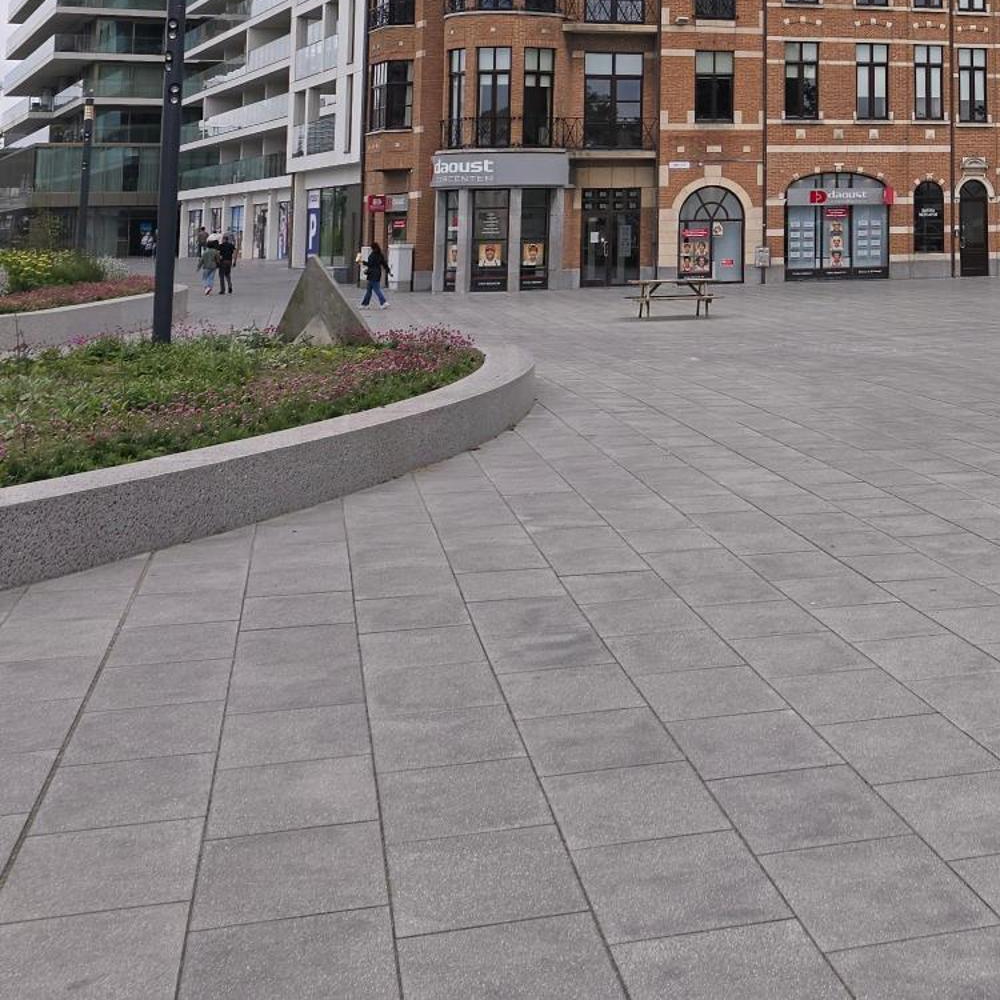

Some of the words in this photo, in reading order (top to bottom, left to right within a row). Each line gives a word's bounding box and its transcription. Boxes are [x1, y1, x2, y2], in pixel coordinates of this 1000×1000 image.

[434, 159, 494, 174] daoust
[827, 189, 868, 199] daoust
[308, 213, 317, 250] P
